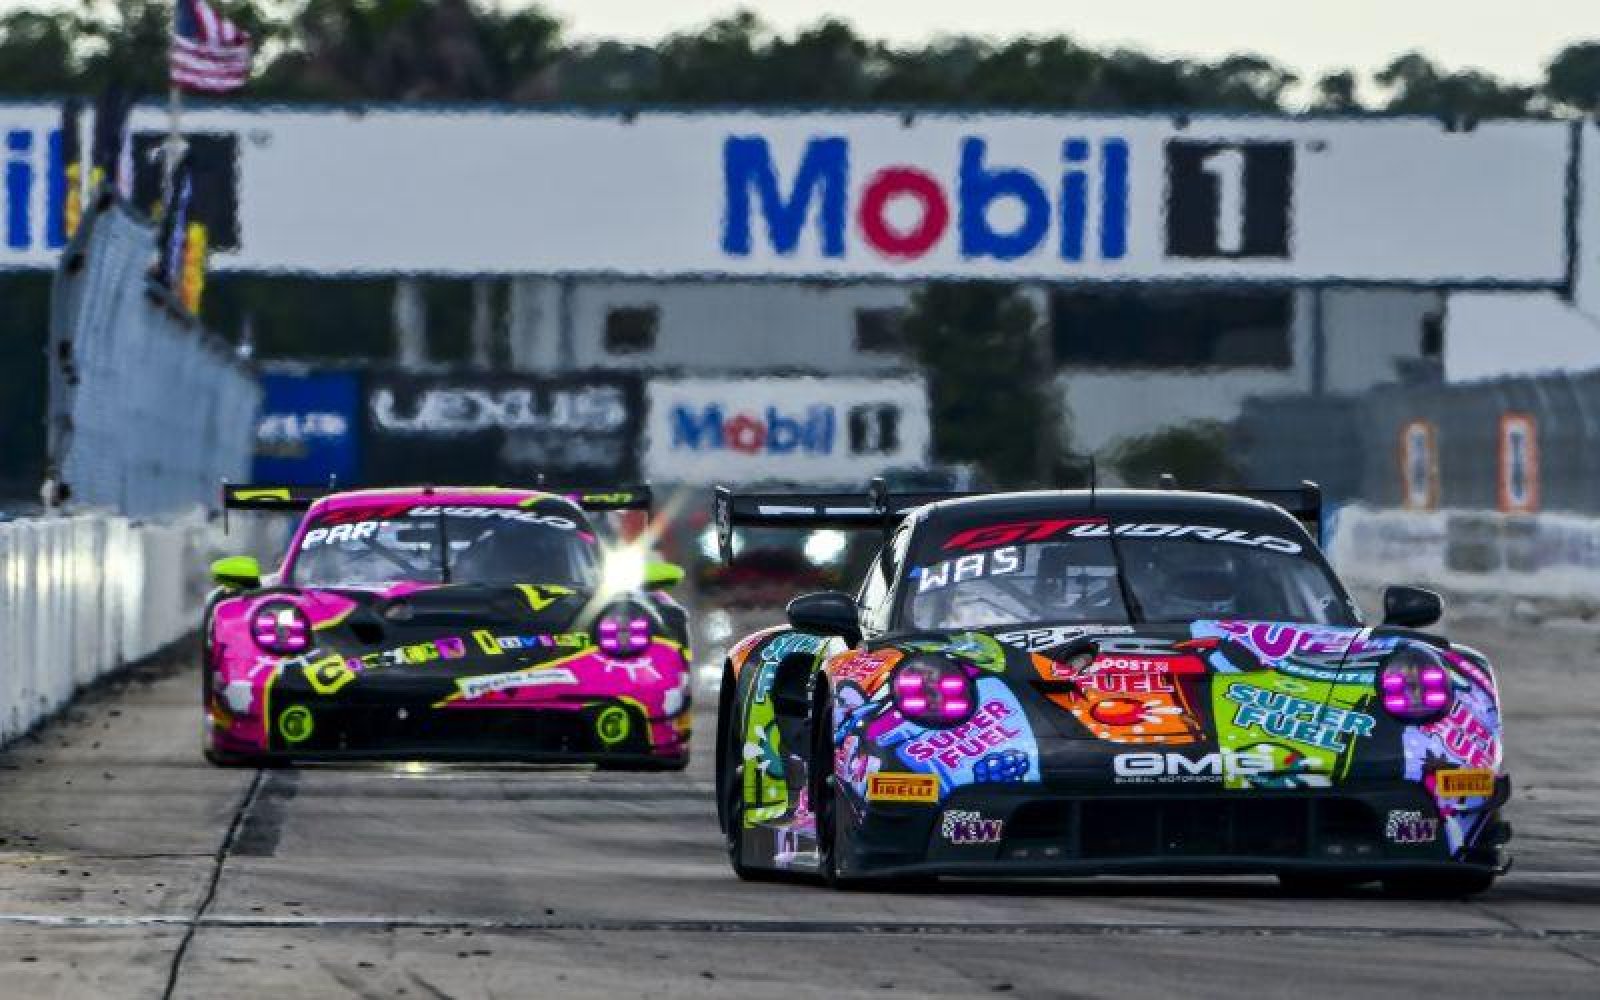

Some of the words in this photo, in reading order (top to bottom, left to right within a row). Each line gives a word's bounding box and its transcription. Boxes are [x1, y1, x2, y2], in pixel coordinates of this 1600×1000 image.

[722, 135, 1129, 261] Mobil
[1200, 149, 1246, 253] 1
[670, 404, 836, 456] Mobil
[942, 517, 1107, 550] GT
[917, 547, 1020, 593] WAS
[905, 700, 1011, 763] SUPER
[1226, 683, 1377, 737] SUPER
[1231, 702, 1346, 754] FUEL
[937, 725, 1023, 770] FUEL
[1114, 752, 1275, 777] GMG
[870, 777, 934, 797] PIRELLI
